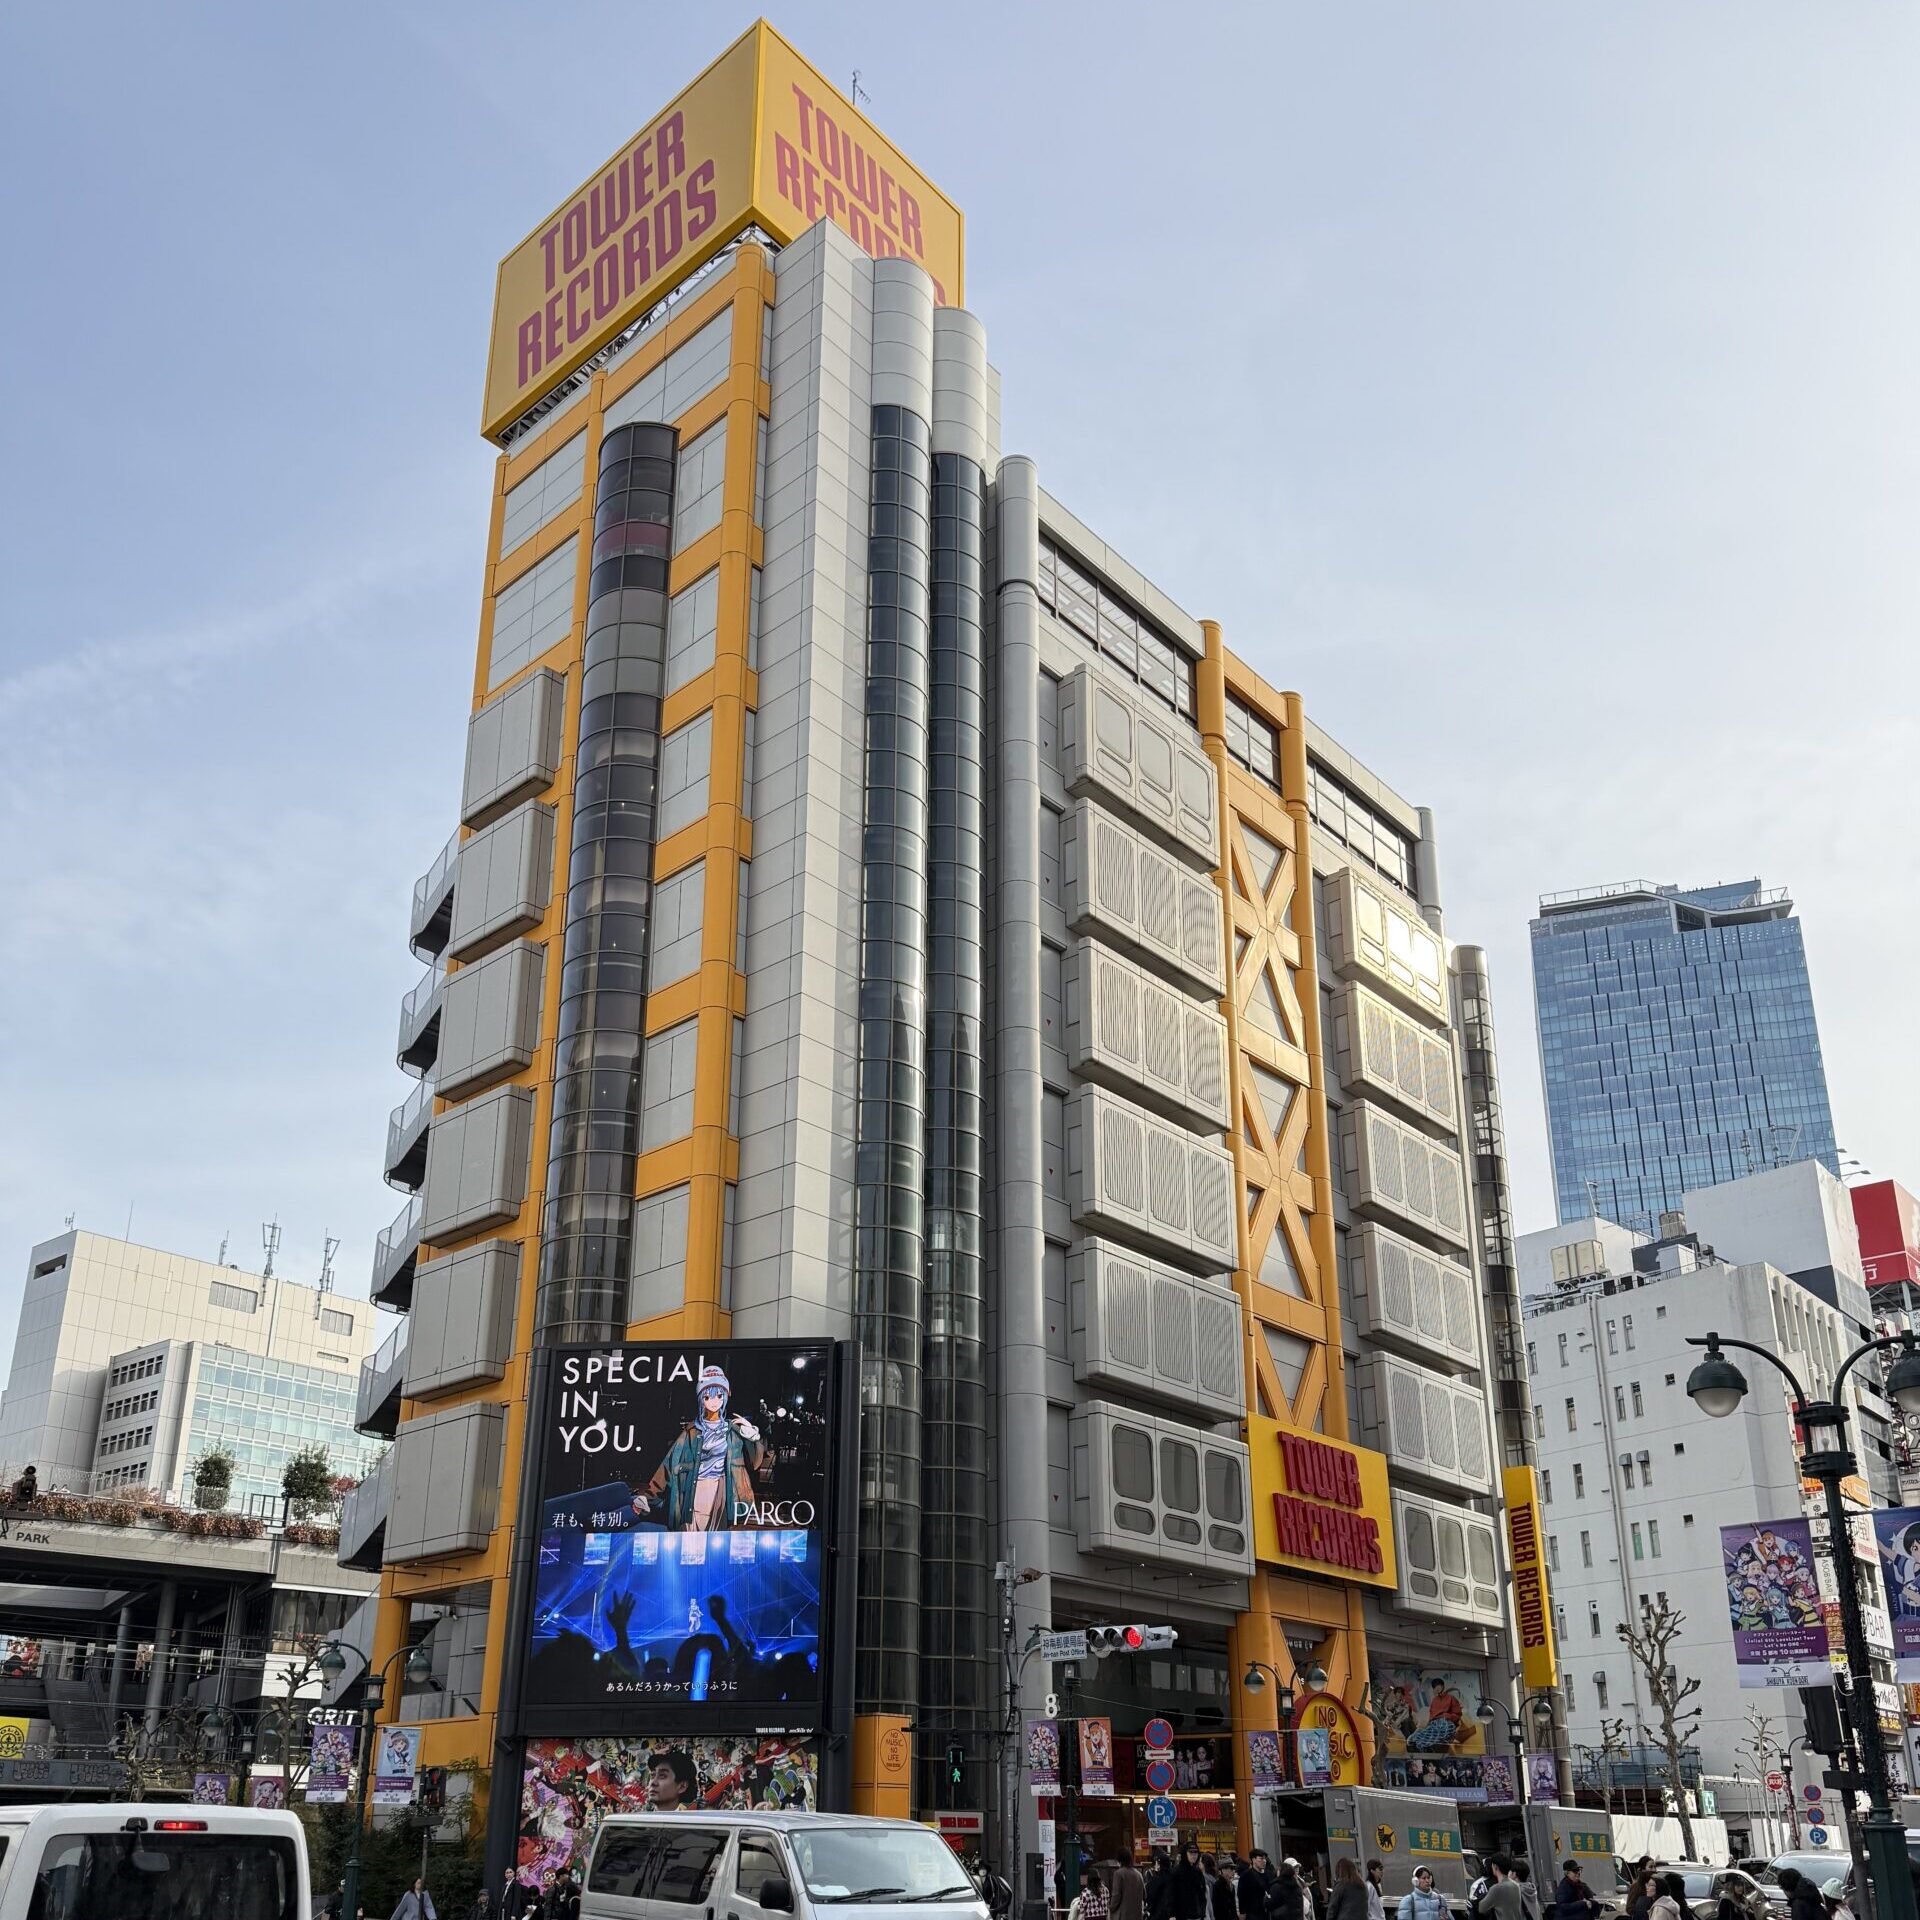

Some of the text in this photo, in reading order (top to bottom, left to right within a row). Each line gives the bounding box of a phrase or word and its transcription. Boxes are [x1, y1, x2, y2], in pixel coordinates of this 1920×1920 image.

[792, 82, 924, 259] TOWER
[540, 110, 686, 294] TOWER
[518, 159, 717, 389] RECORDS
[562, 1355, 705, 1384] SPECIAL
[560, 1390, 598, 1418] IN
[559, 1425, 641, 1452] YOU.
[1277, 1431, 1364, 1508] TOWER
[552, 1512, 629, 1528] 君も、特別。
[733, 1500, 815, 1526] PARCO
[16, 1532, 50, 1544] PARK
[1272, 1493, 1384, 1574] RECORDS
[1510, 1502, 1545, 1648] TOWER RECORDS
[307, 1706, 358, 1726] GRIT
[1315, 1706, 1337, 1727] NO
[1329, 1731, 1356, 1758] SIC,
[1155, 1805, 1165, 1824] P
[1162, 1815, 1170, 1825] 40
[1419, 1830, 1450, 1850] 宅急便
[1573, 1834, 1607, 1850] 宅急便
